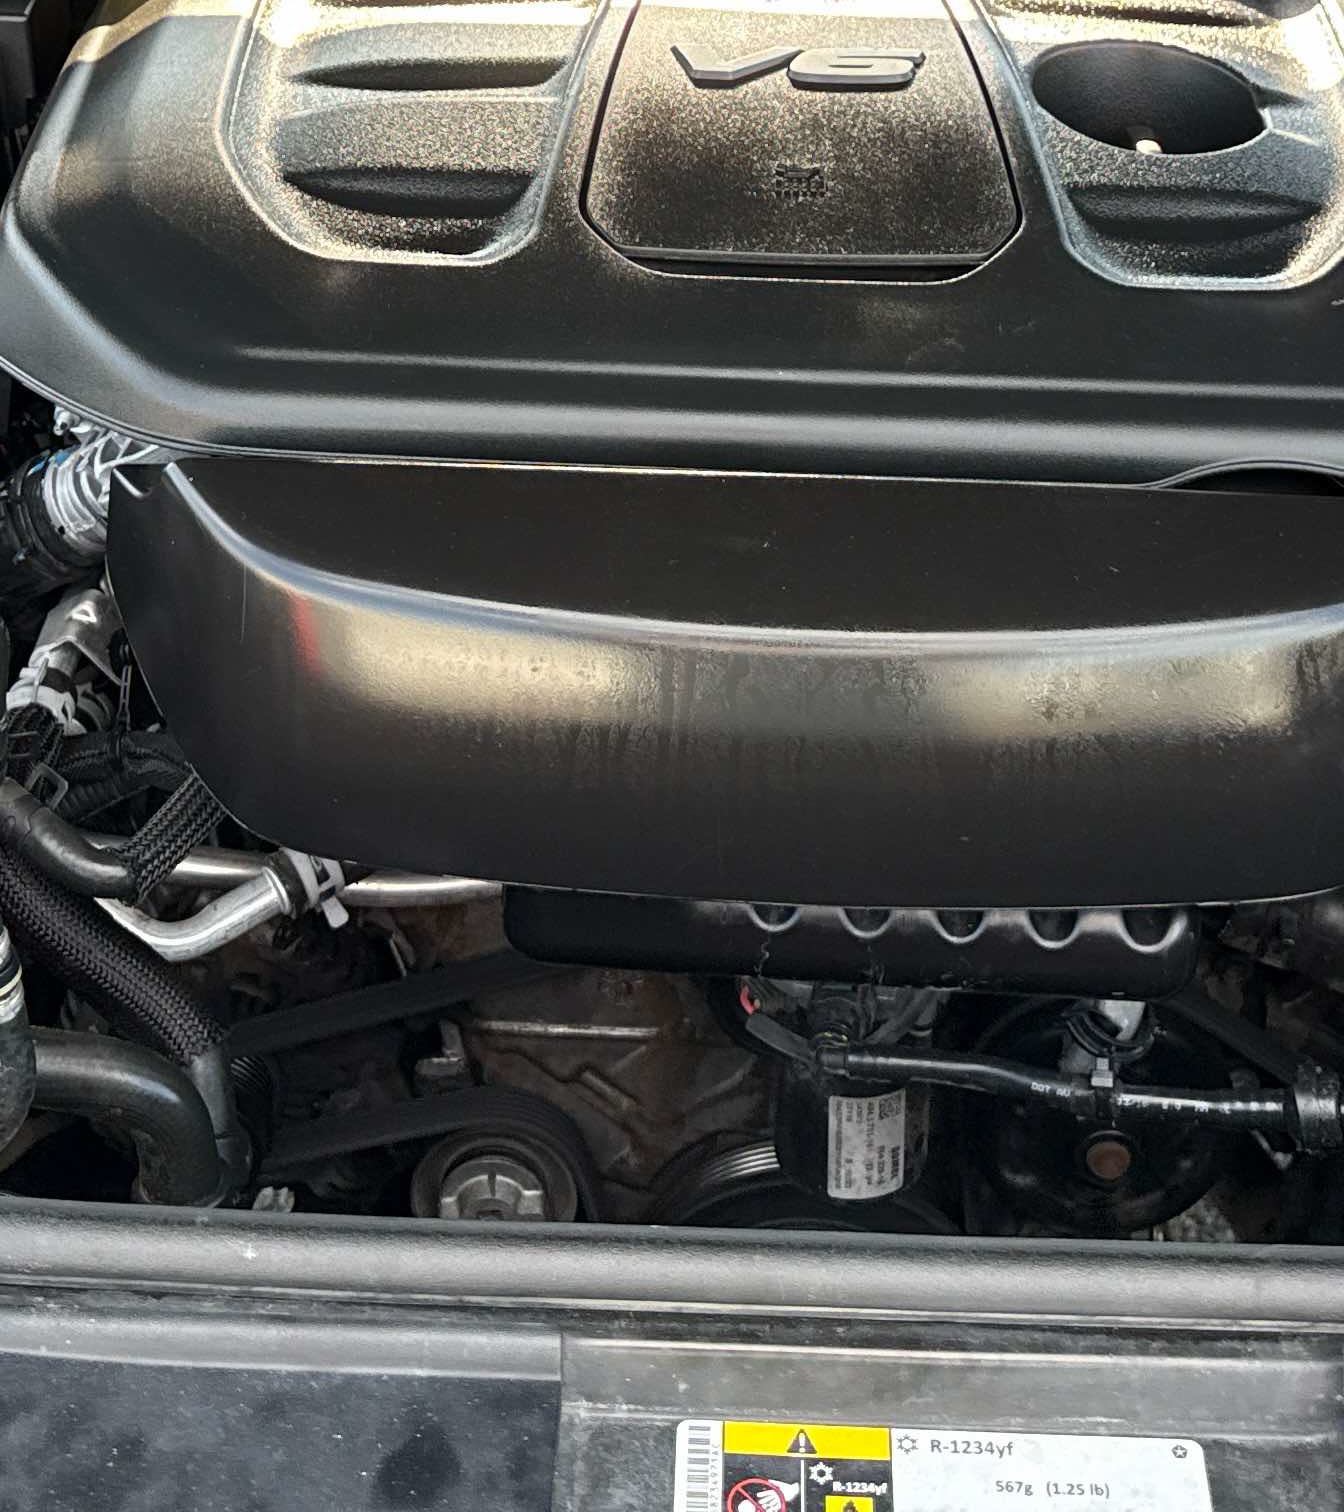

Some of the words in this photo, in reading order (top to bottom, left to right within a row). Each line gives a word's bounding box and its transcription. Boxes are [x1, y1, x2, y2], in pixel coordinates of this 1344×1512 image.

[670, 44, 927, 91] V6
[930, 1439, 1014, 1458] R-1234yf
[832, 1481, 889, 1495] R-1234yf
[995, 1480, 1033, 1496] 567g
[1045, 1481, 1085, 1496] (1.25
[1090, 1482, 1110, 1498] lb)
